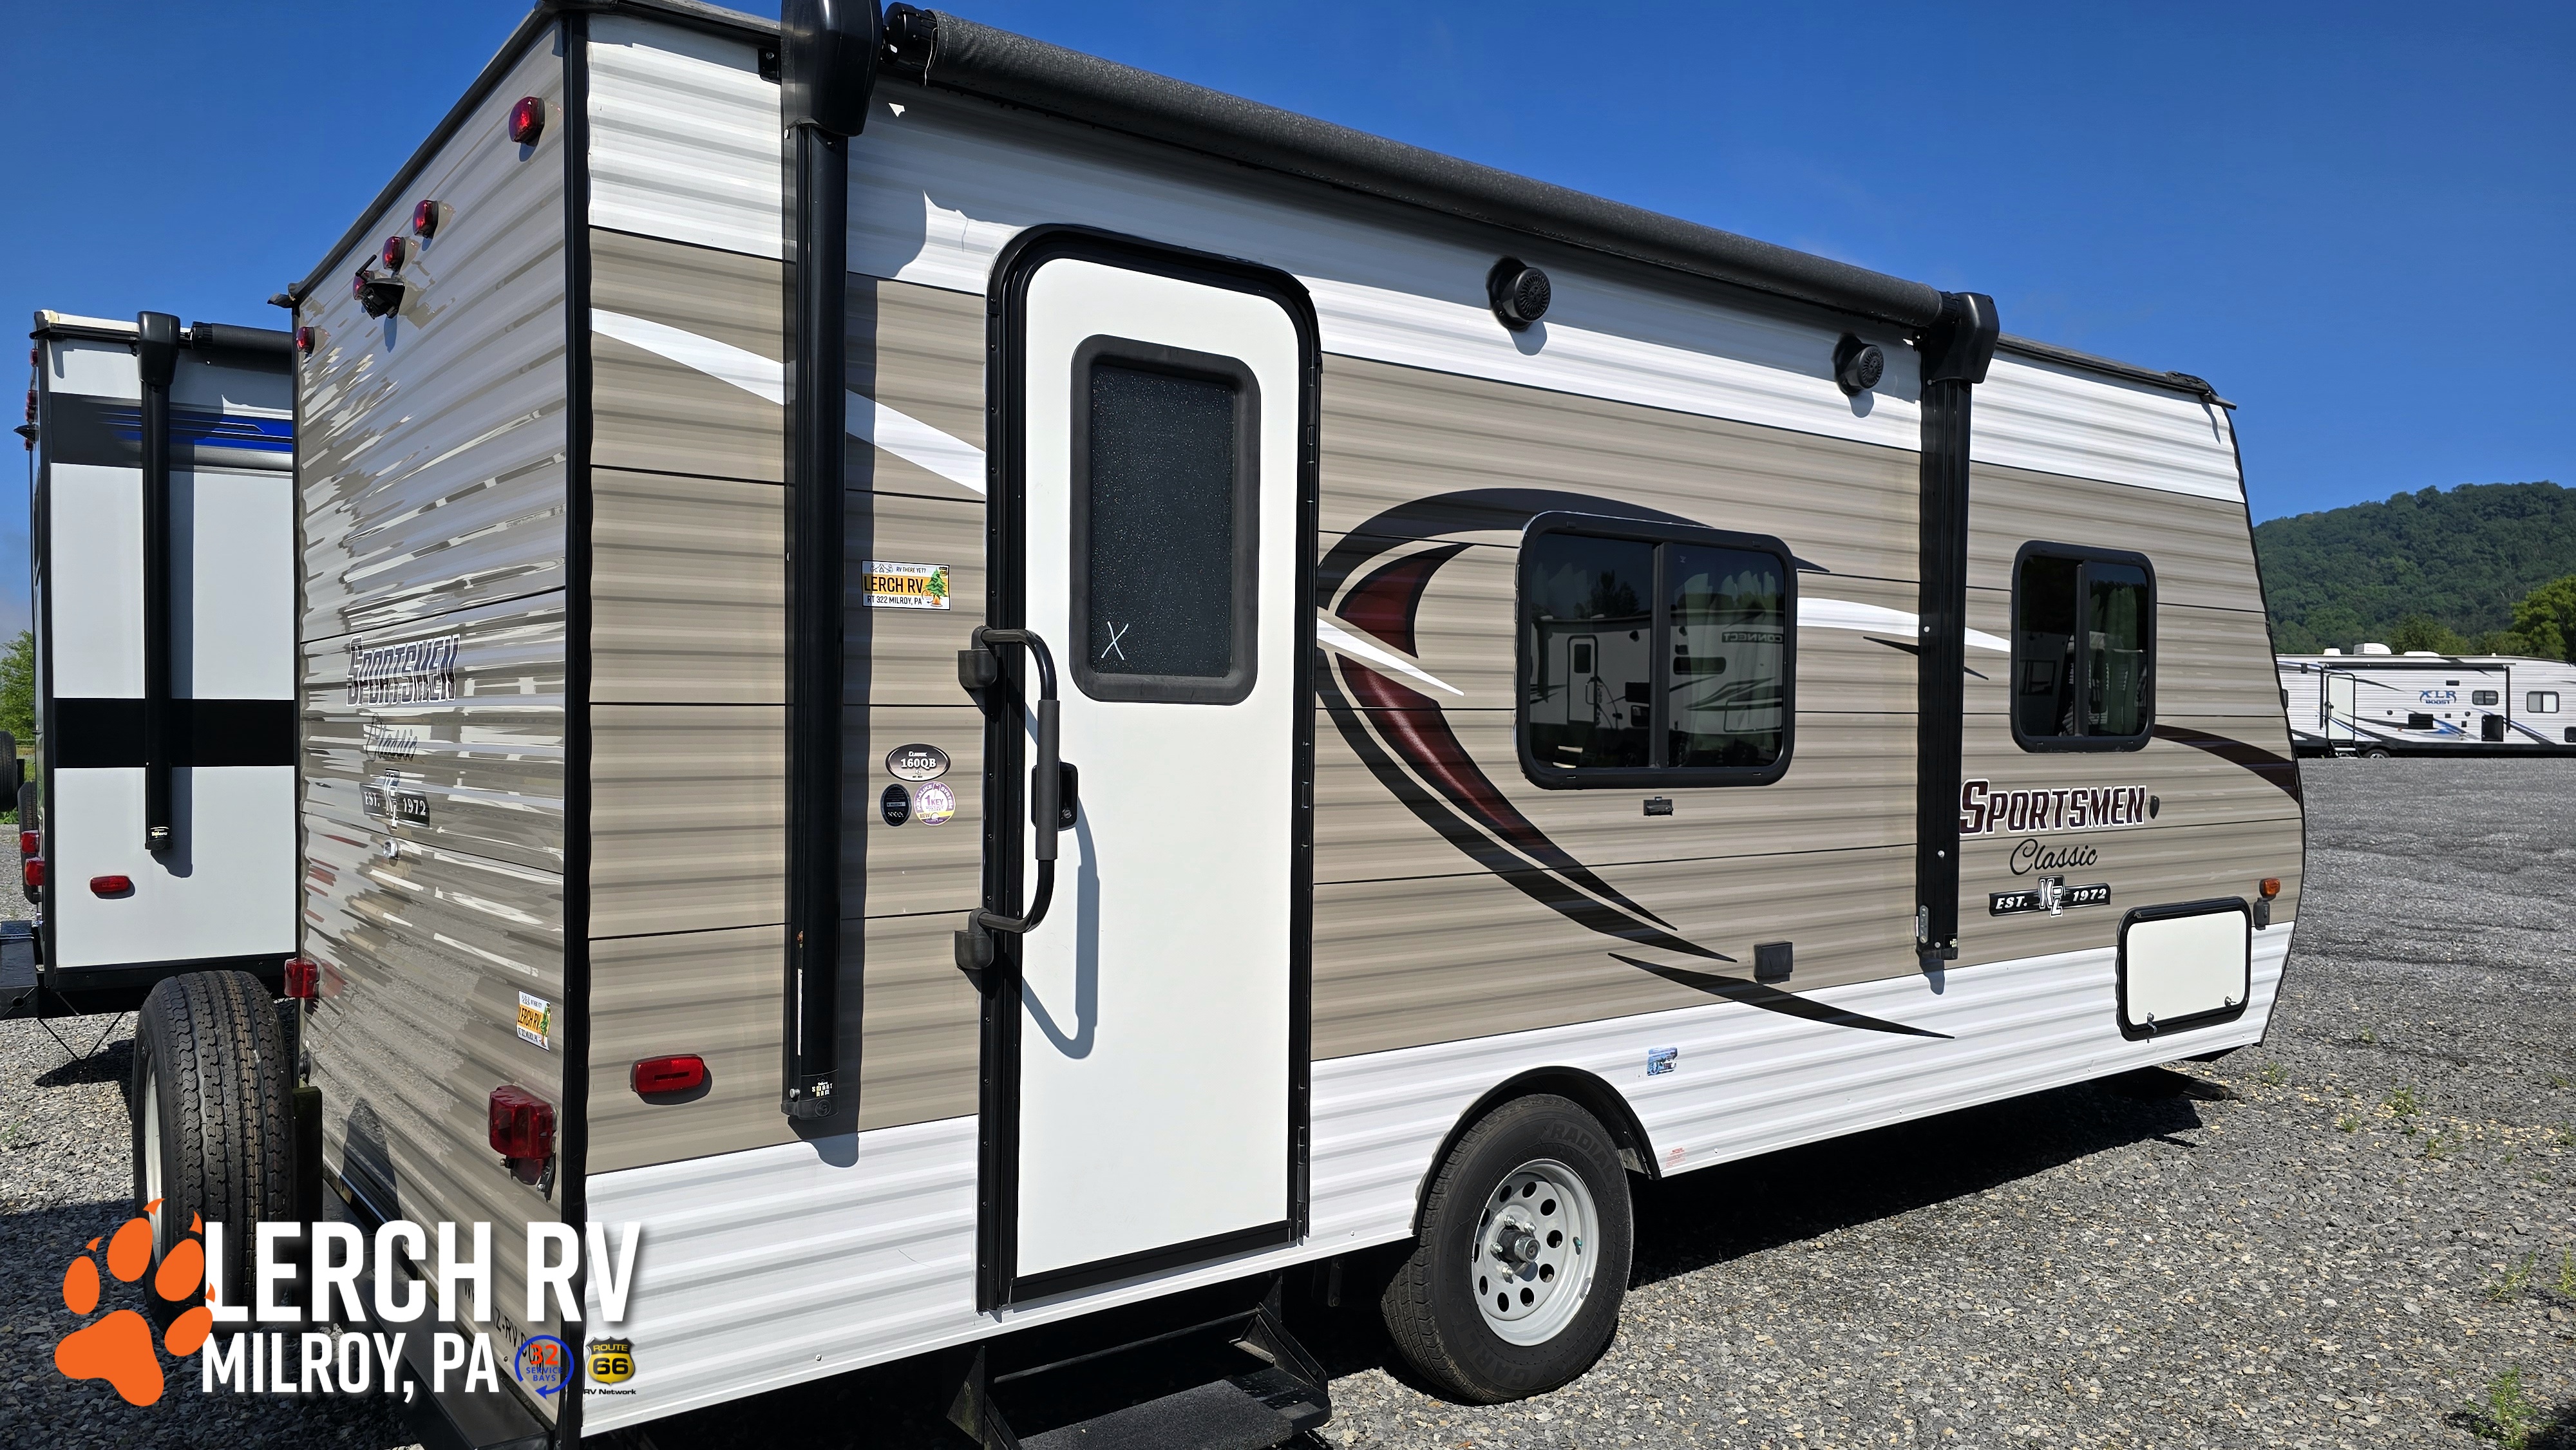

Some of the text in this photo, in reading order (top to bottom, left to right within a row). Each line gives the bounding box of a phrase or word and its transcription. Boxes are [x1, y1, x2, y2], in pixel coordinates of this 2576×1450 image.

[864, 576, 923, 593] LERCH RV
[867, 595, 875, 603] RT
[876, 596, 888, 604] 322
[889, 596, 913, 606] MILROY,
[914, 597, 922, 605] PA
[2419, 690, 2456, 699] XLR
[900, 758, 936, 769] 160QB
[364, 791, 381, 807] EST.
[402, 797, 426, 816] 1972
[1959, 778, 2146, 836] SPORTSMEN
[2010, 838, 2098, 875] Classic
[1995, 896, 2028, 910] EST.
[2072, 888, 2107, 902] 1972
